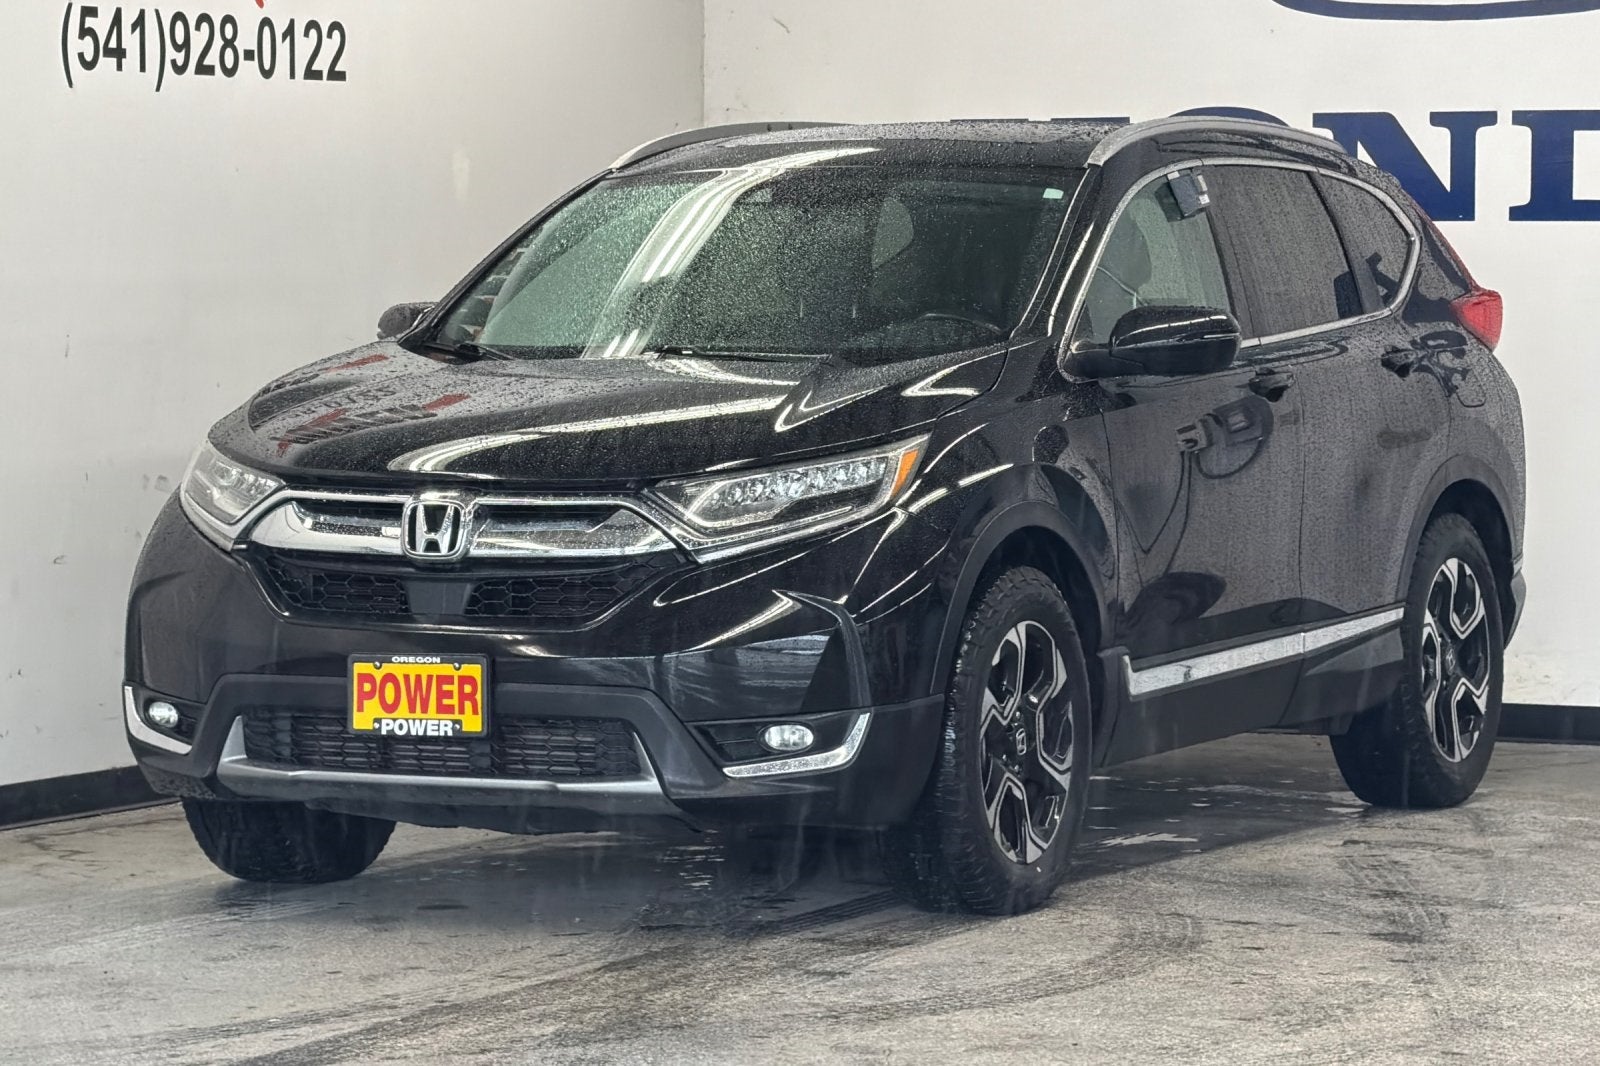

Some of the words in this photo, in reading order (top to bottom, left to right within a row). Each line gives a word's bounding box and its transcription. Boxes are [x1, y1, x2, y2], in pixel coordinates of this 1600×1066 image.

[61, 2, 347, 92] (541)928-0122
[391, 656, 441, 664] OREGON
[356, 672, 479, 716] POWER
[380, 718, 453, 736] POWER
